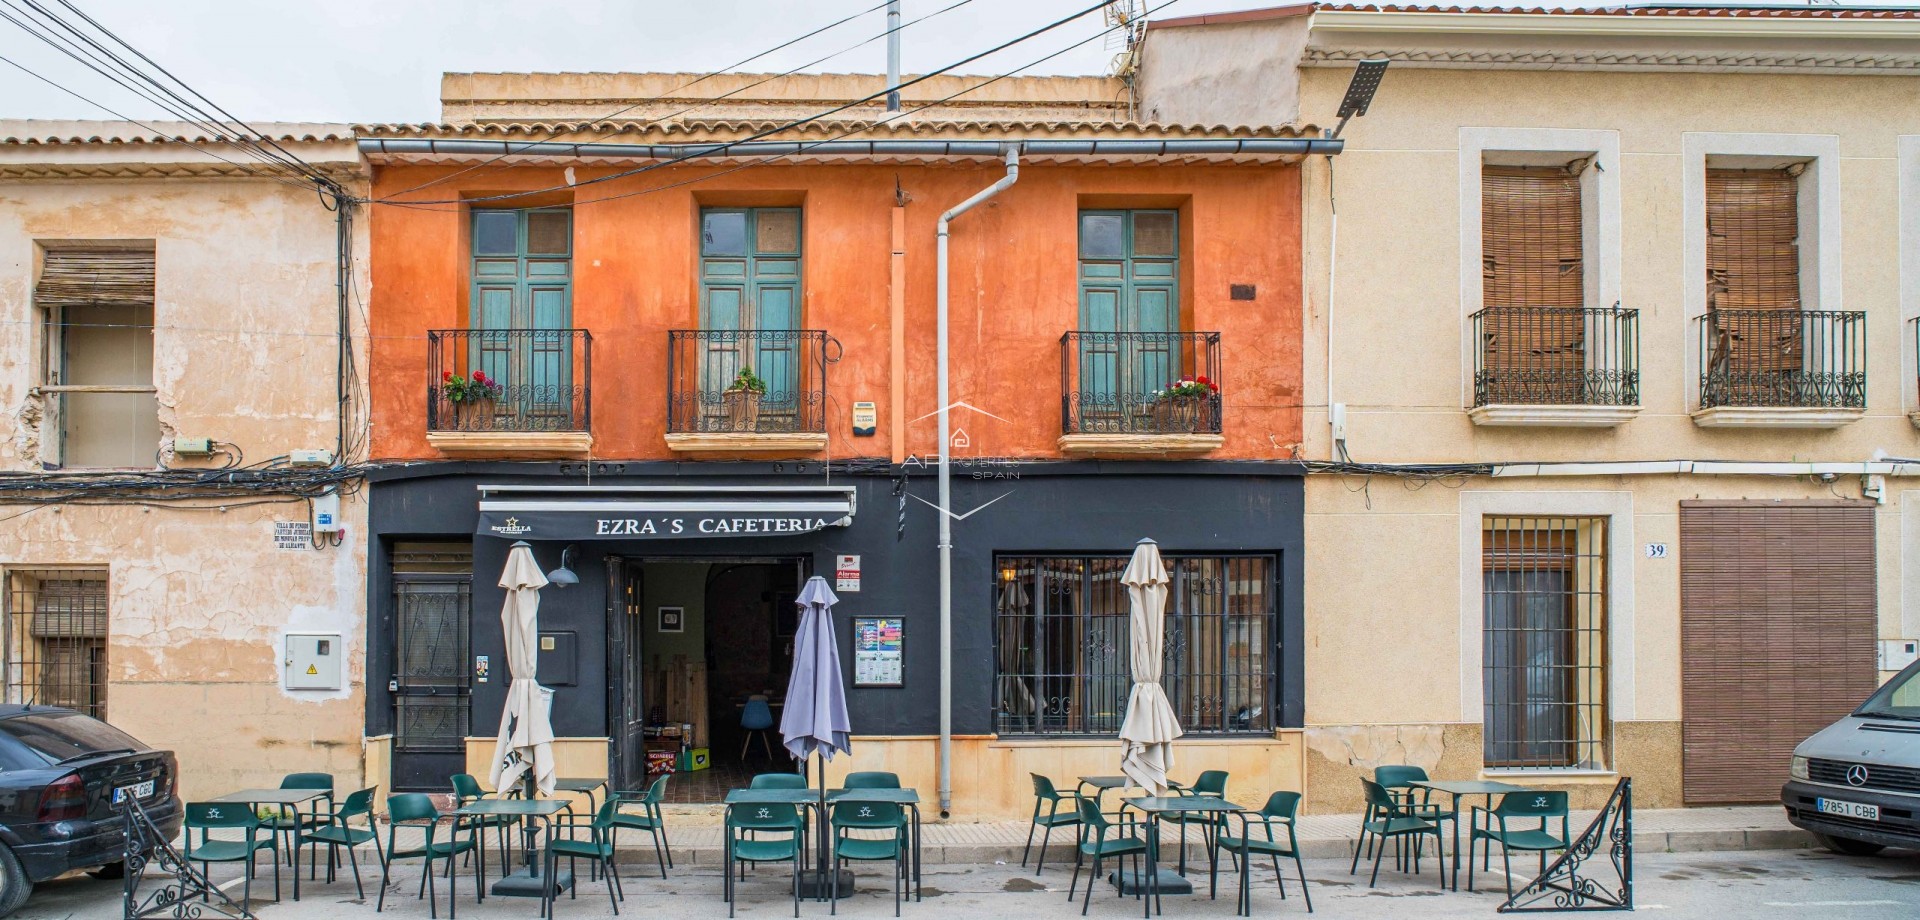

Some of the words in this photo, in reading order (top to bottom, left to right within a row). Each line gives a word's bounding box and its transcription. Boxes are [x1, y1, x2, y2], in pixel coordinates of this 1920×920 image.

[699, 518, 828, 532] CAFETERIA
[1649, 544, 1664, 556] 39
[837, 570, 860, 578] Alarma
[1824, 800, 1850, 814] 7851
[1854, 805, 1877, 819] CBB
